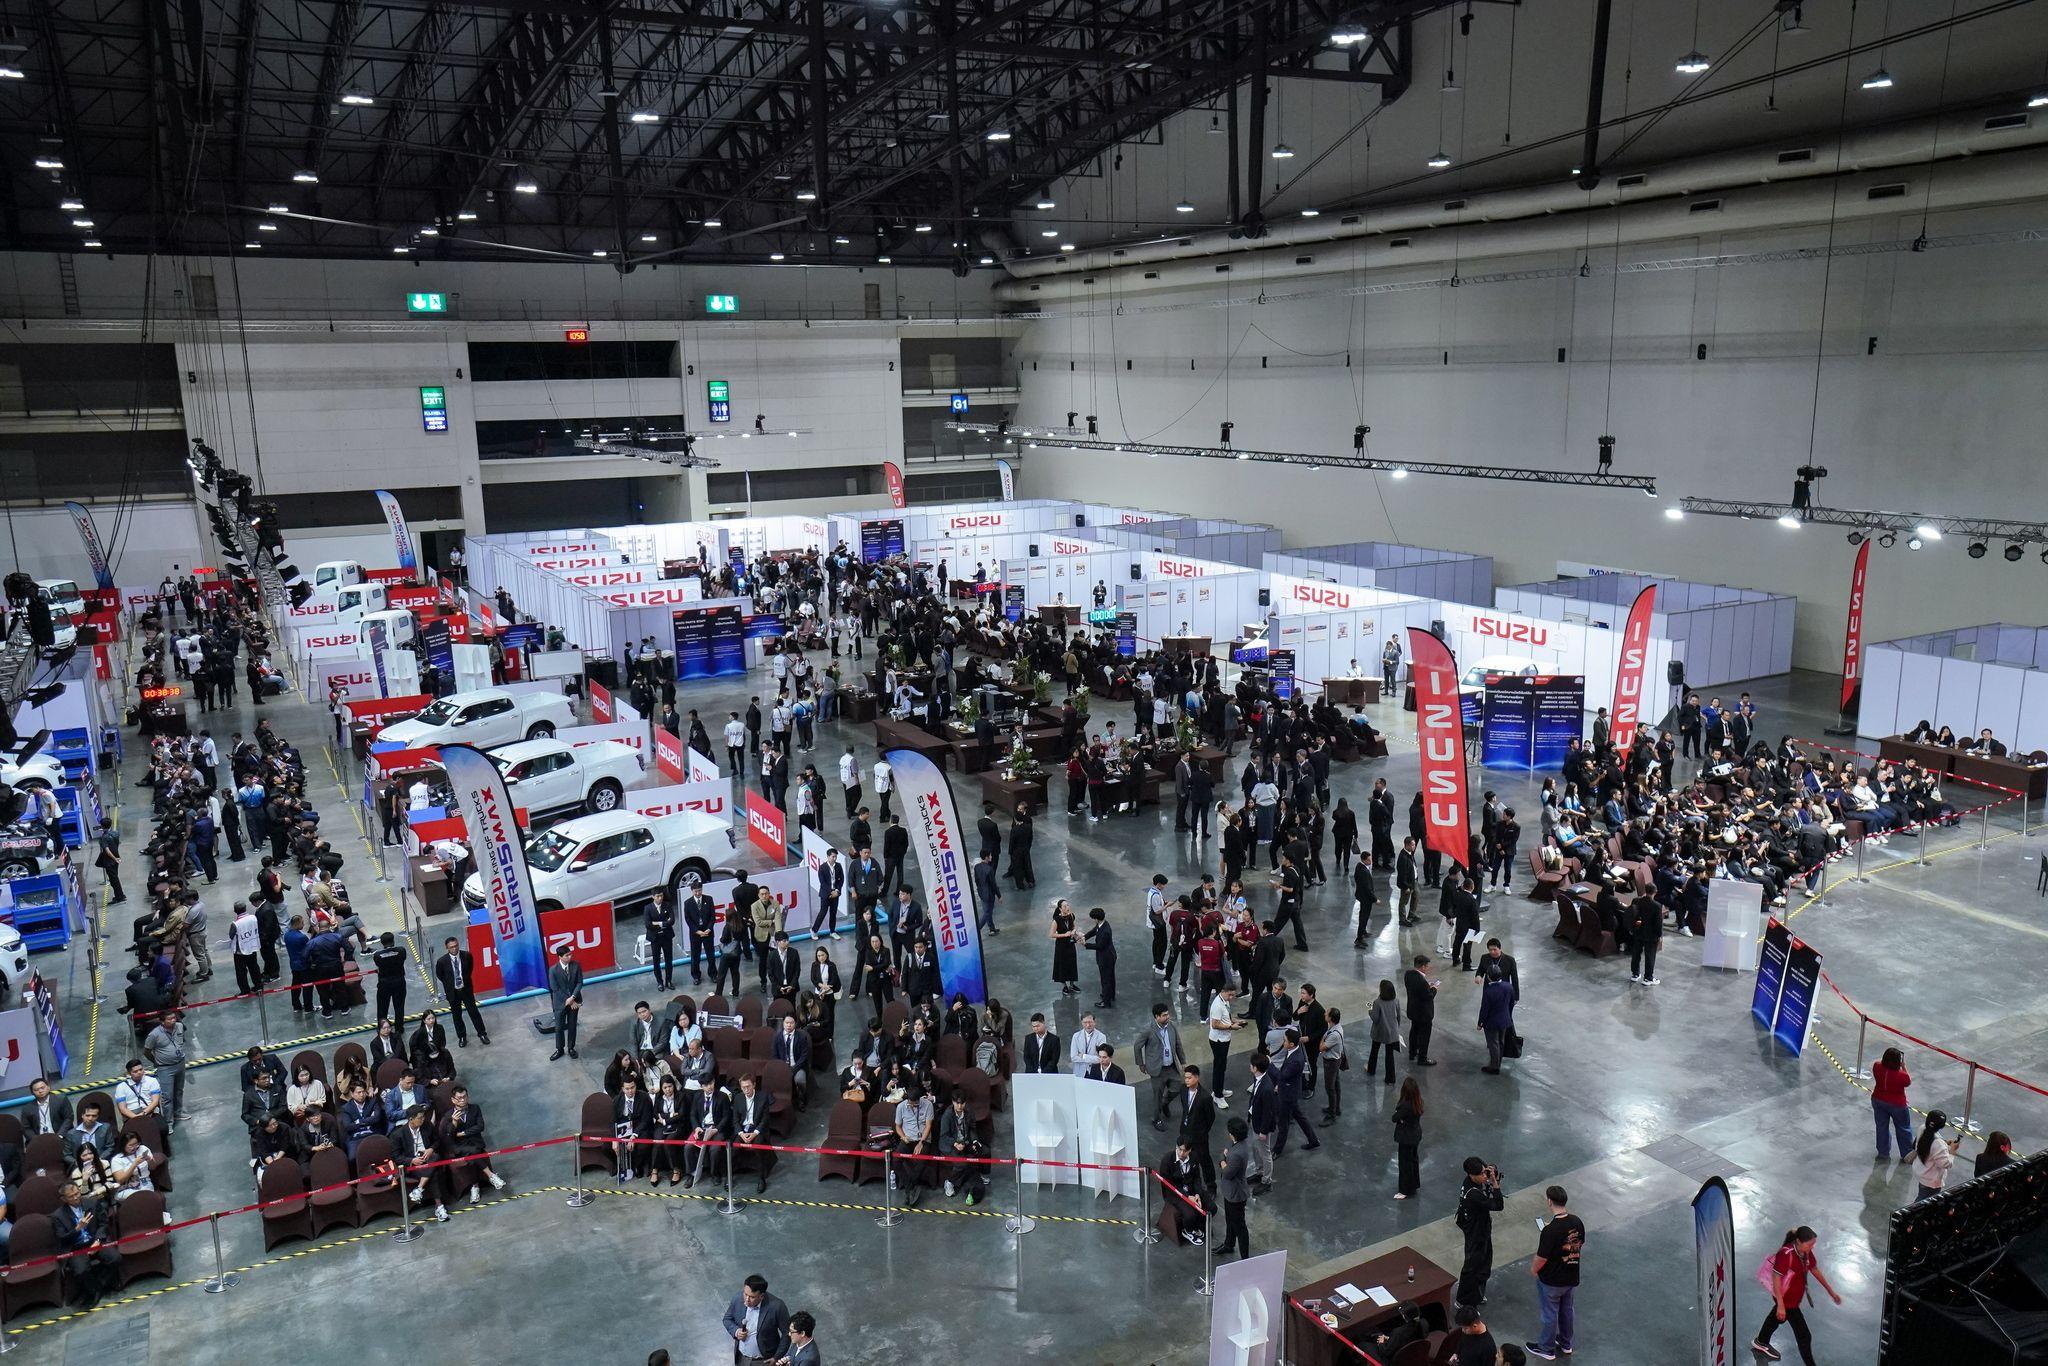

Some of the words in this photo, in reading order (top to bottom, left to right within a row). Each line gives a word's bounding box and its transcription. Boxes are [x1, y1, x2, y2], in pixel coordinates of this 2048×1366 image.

[456, 368, 463, 379] 4
[688, 365, 694, 375] 3
[889, 362, 894, 371] 2
[188, 371, 197, 384] 5
[953, 400, 968, 409] G1
[803, 523, 824, 536] ISUZU
[951, 515, 1001, 528] ISUZU
[1054, 541, 1088, 554] ISUZU
[1158, 560, 1203, 577] ISUZU
[568, 572, 641, 587] ISUZU
[603, 589, 683, 607] ISUZU
[1294, 585, 1349, 608] ISUZU
[1473, 616, 1547, 646] ISUZU
[1845, 569, 1863, 679] ISUZU
[144, 688, 181, 698] 00:38:38
[1615, 622, 1642, 750] ISUZU
[657, 741, 680, 770] ISUZU
[471, 790, 488, 833] TRUCKS
[917, 795, 934, 841] TRUCKS
[750, 810, 782, 845] ISUZU
[484, 835, 494, 850] OF
[929, 842, 938, 857] OF
[488, 850, 499, 875] KING
[933, 858, 944, 884] KING
[491, 877, 514, 941] ISUZU
[935, 886, 955, 952] ISUZU
